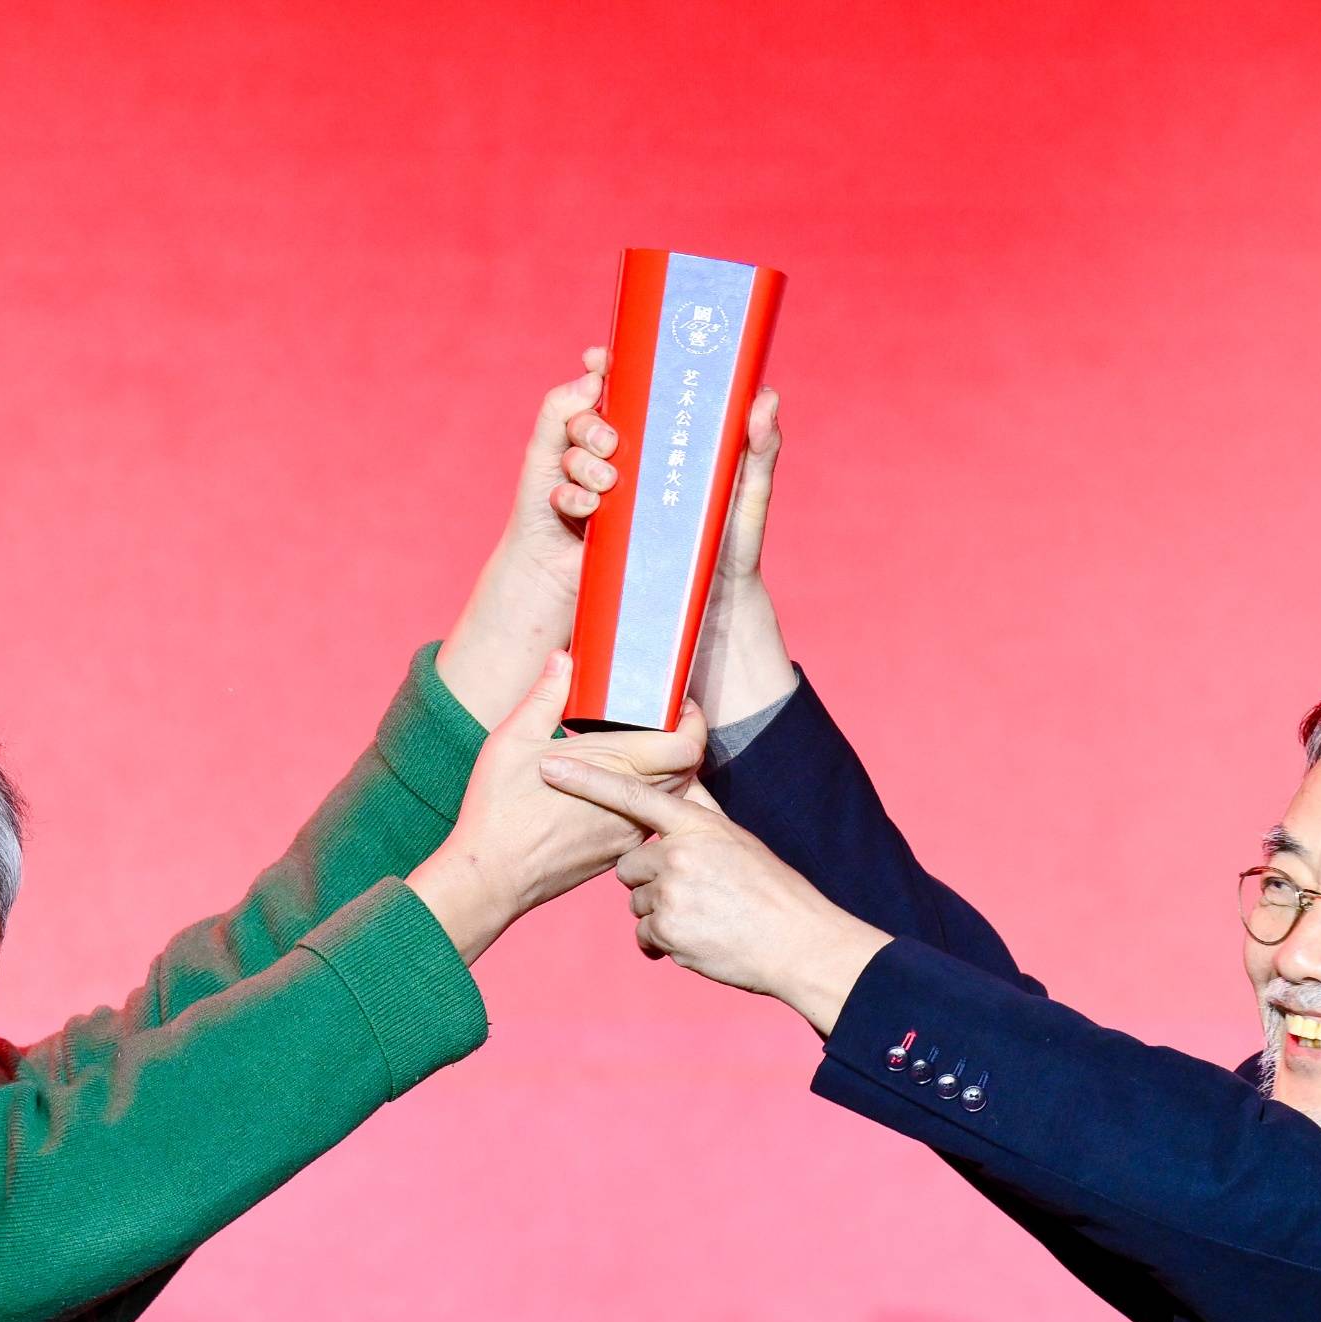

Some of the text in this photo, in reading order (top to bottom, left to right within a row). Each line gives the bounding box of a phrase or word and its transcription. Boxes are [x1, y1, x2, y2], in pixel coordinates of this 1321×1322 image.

[662, 368, 700, 507] 艺术公益薪火杯
